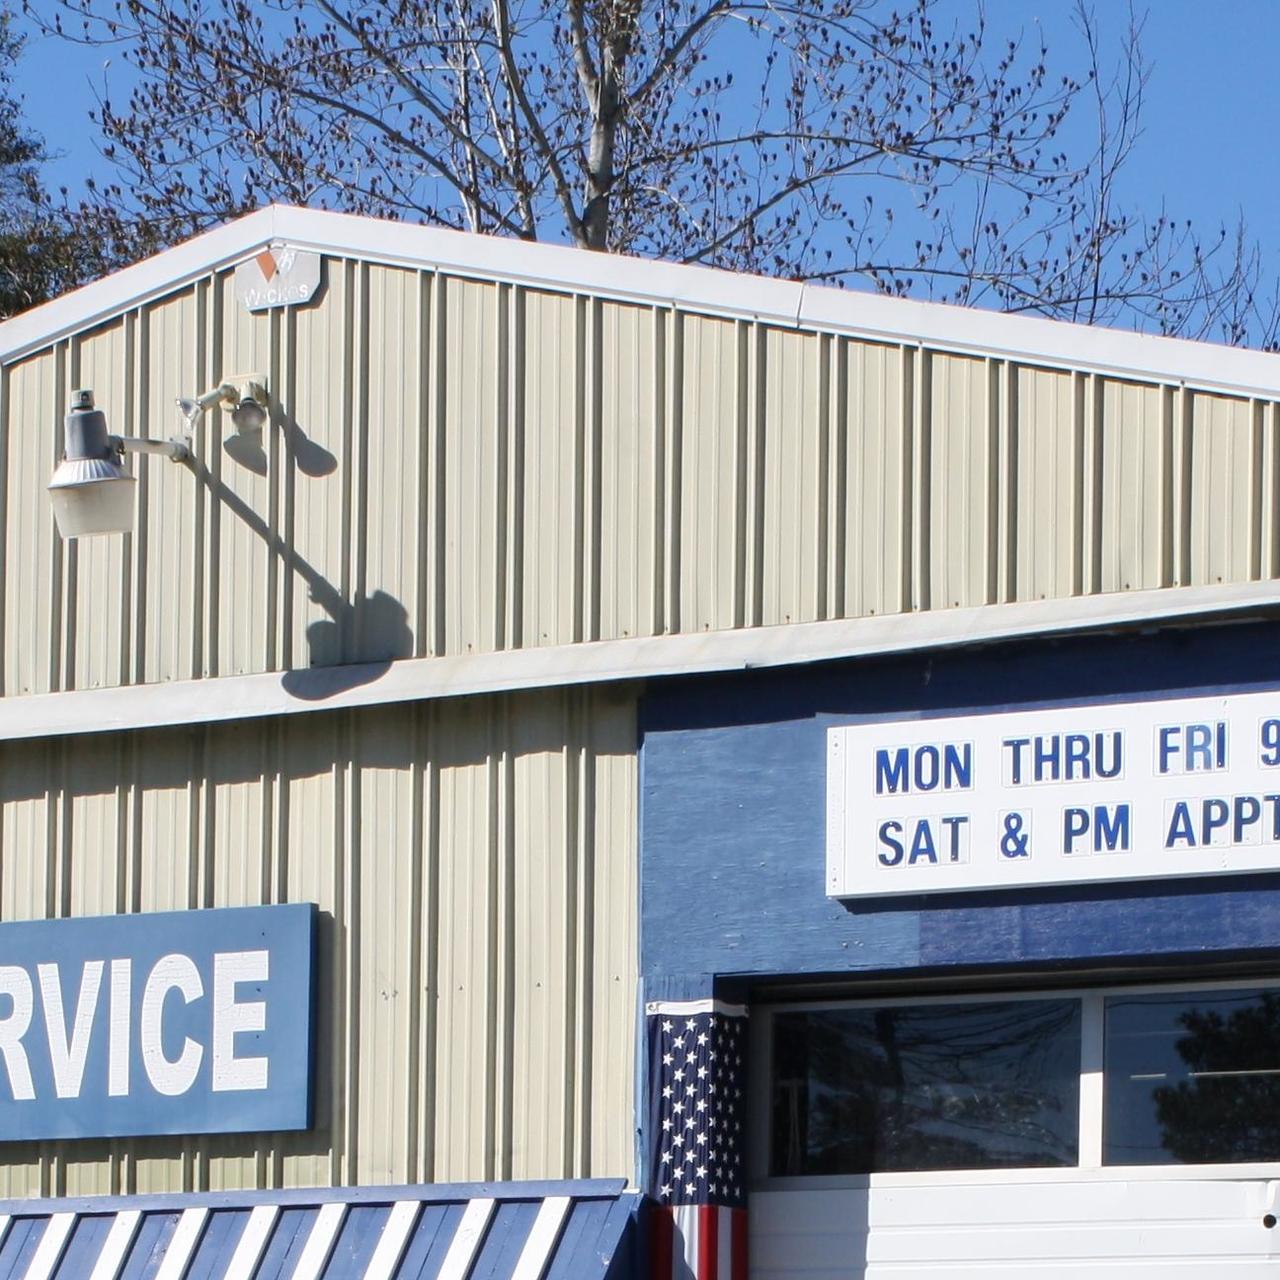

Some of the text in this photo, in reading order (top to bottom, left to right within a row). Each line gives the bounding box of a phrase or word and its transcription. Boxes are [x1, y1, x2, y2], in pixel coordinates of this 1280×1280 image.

[875, 743, 971, 795] MON
[1003, 731, 1122, 785] THRU
[1159, 722, 1226, 774] FRI
[878, 816, 968, 866] SAT
[1000, 811, 1029, 858] &
[1063, 804, 1130, 854] PM
